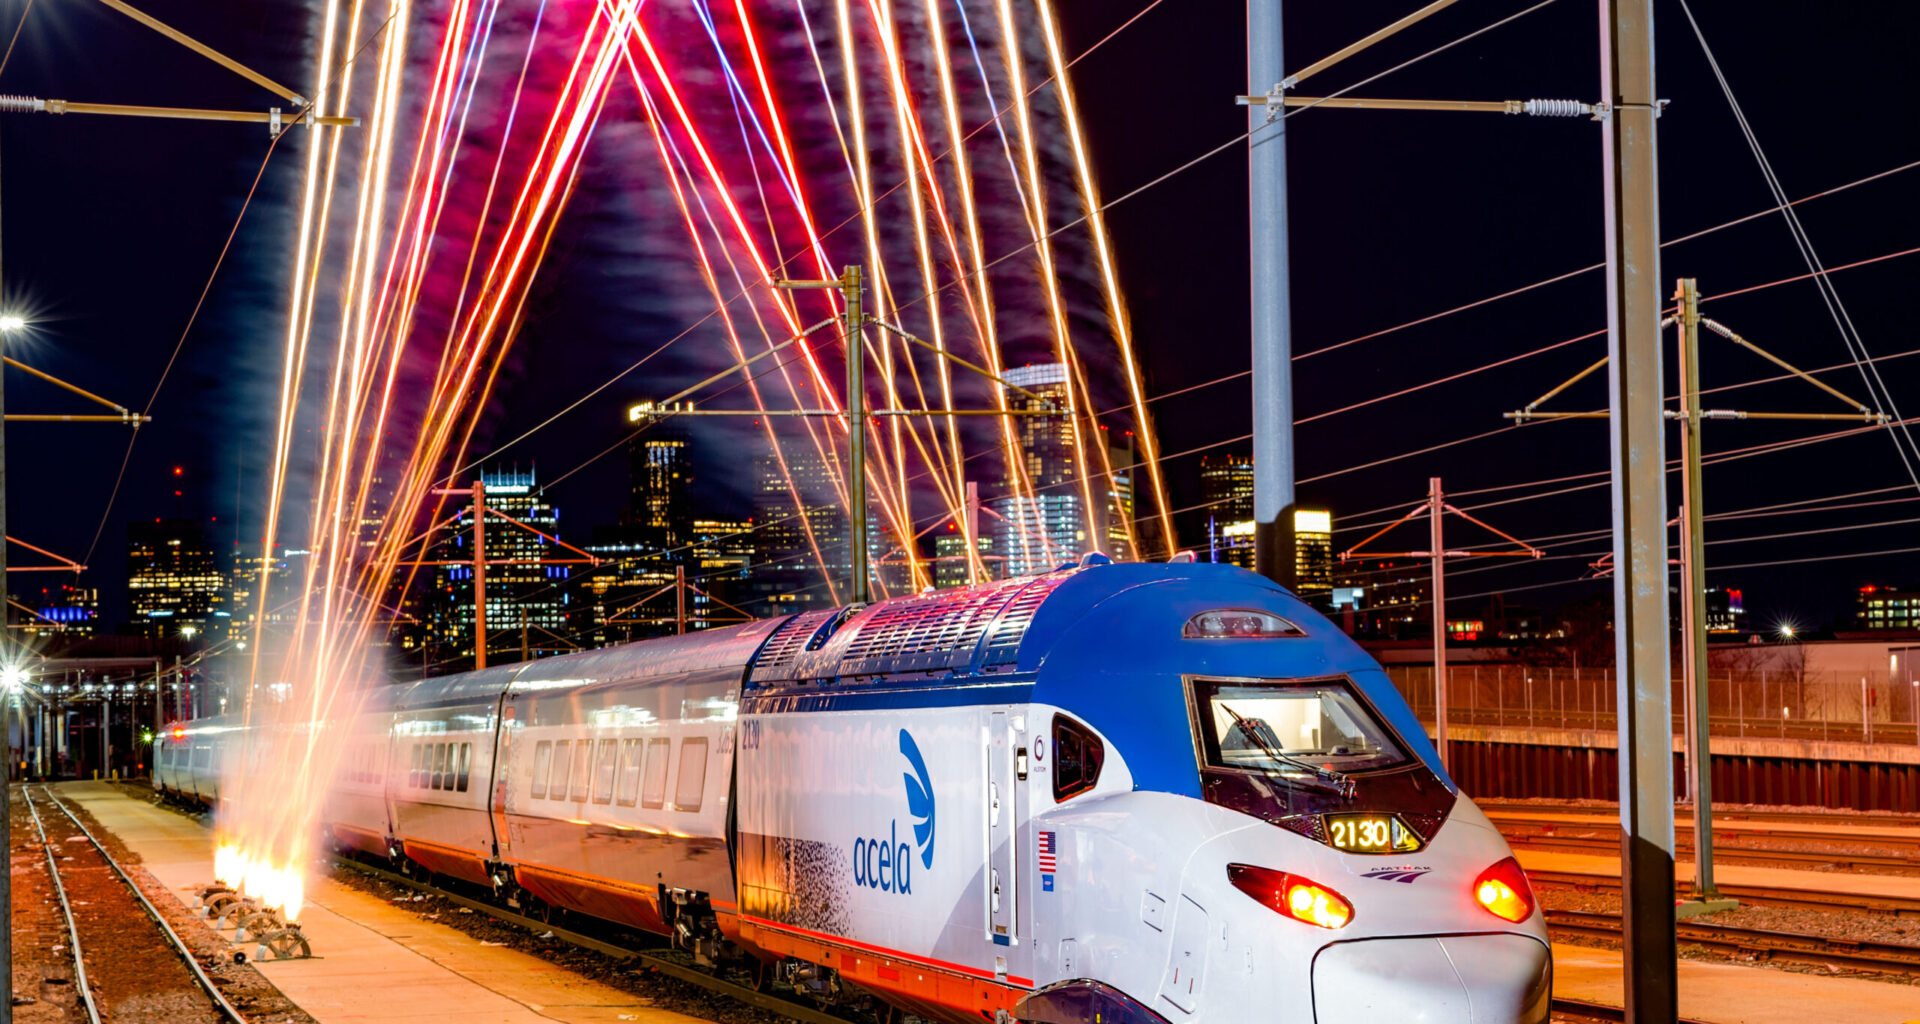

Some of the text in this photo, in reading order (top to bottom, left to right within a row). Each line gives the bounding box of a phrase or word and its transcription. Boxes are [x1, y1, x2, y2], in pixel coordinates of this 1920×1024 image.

[742, 719, 760, 750] 2130
[1331, 820, 1388, 847] 2130
[854, 819, 912, 895] acela
